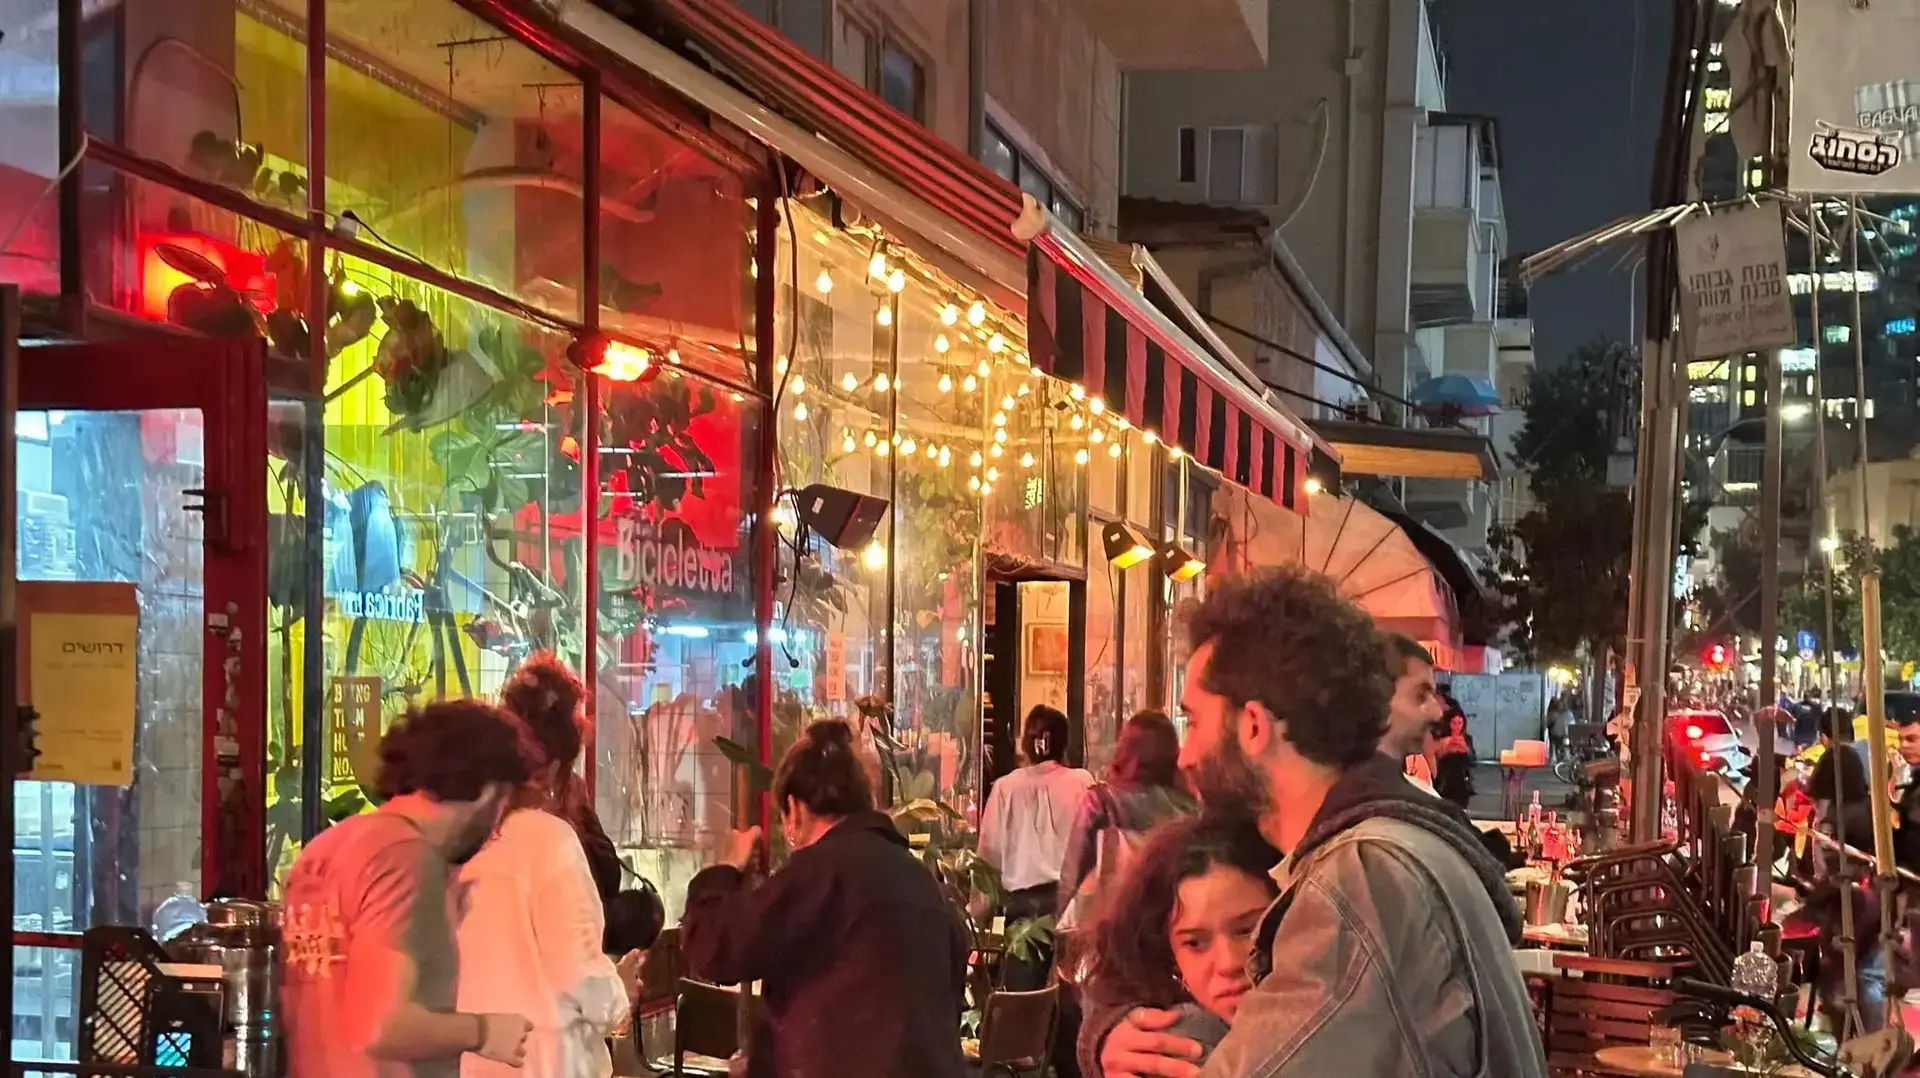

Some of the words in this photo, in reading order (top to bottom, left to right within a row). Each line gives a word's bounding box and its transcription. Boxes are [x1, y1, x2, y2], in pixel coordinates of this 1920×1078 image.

[1742, 262, 1779, 282] מתח
[1697, 288, 1731, 307] מוות
[1740, 281, 1781, 300] סכנת
[62, 641, 125, 655] דרושים
[334, 684, 371, 703] BNG
[334, 757, 354, 777] NO
